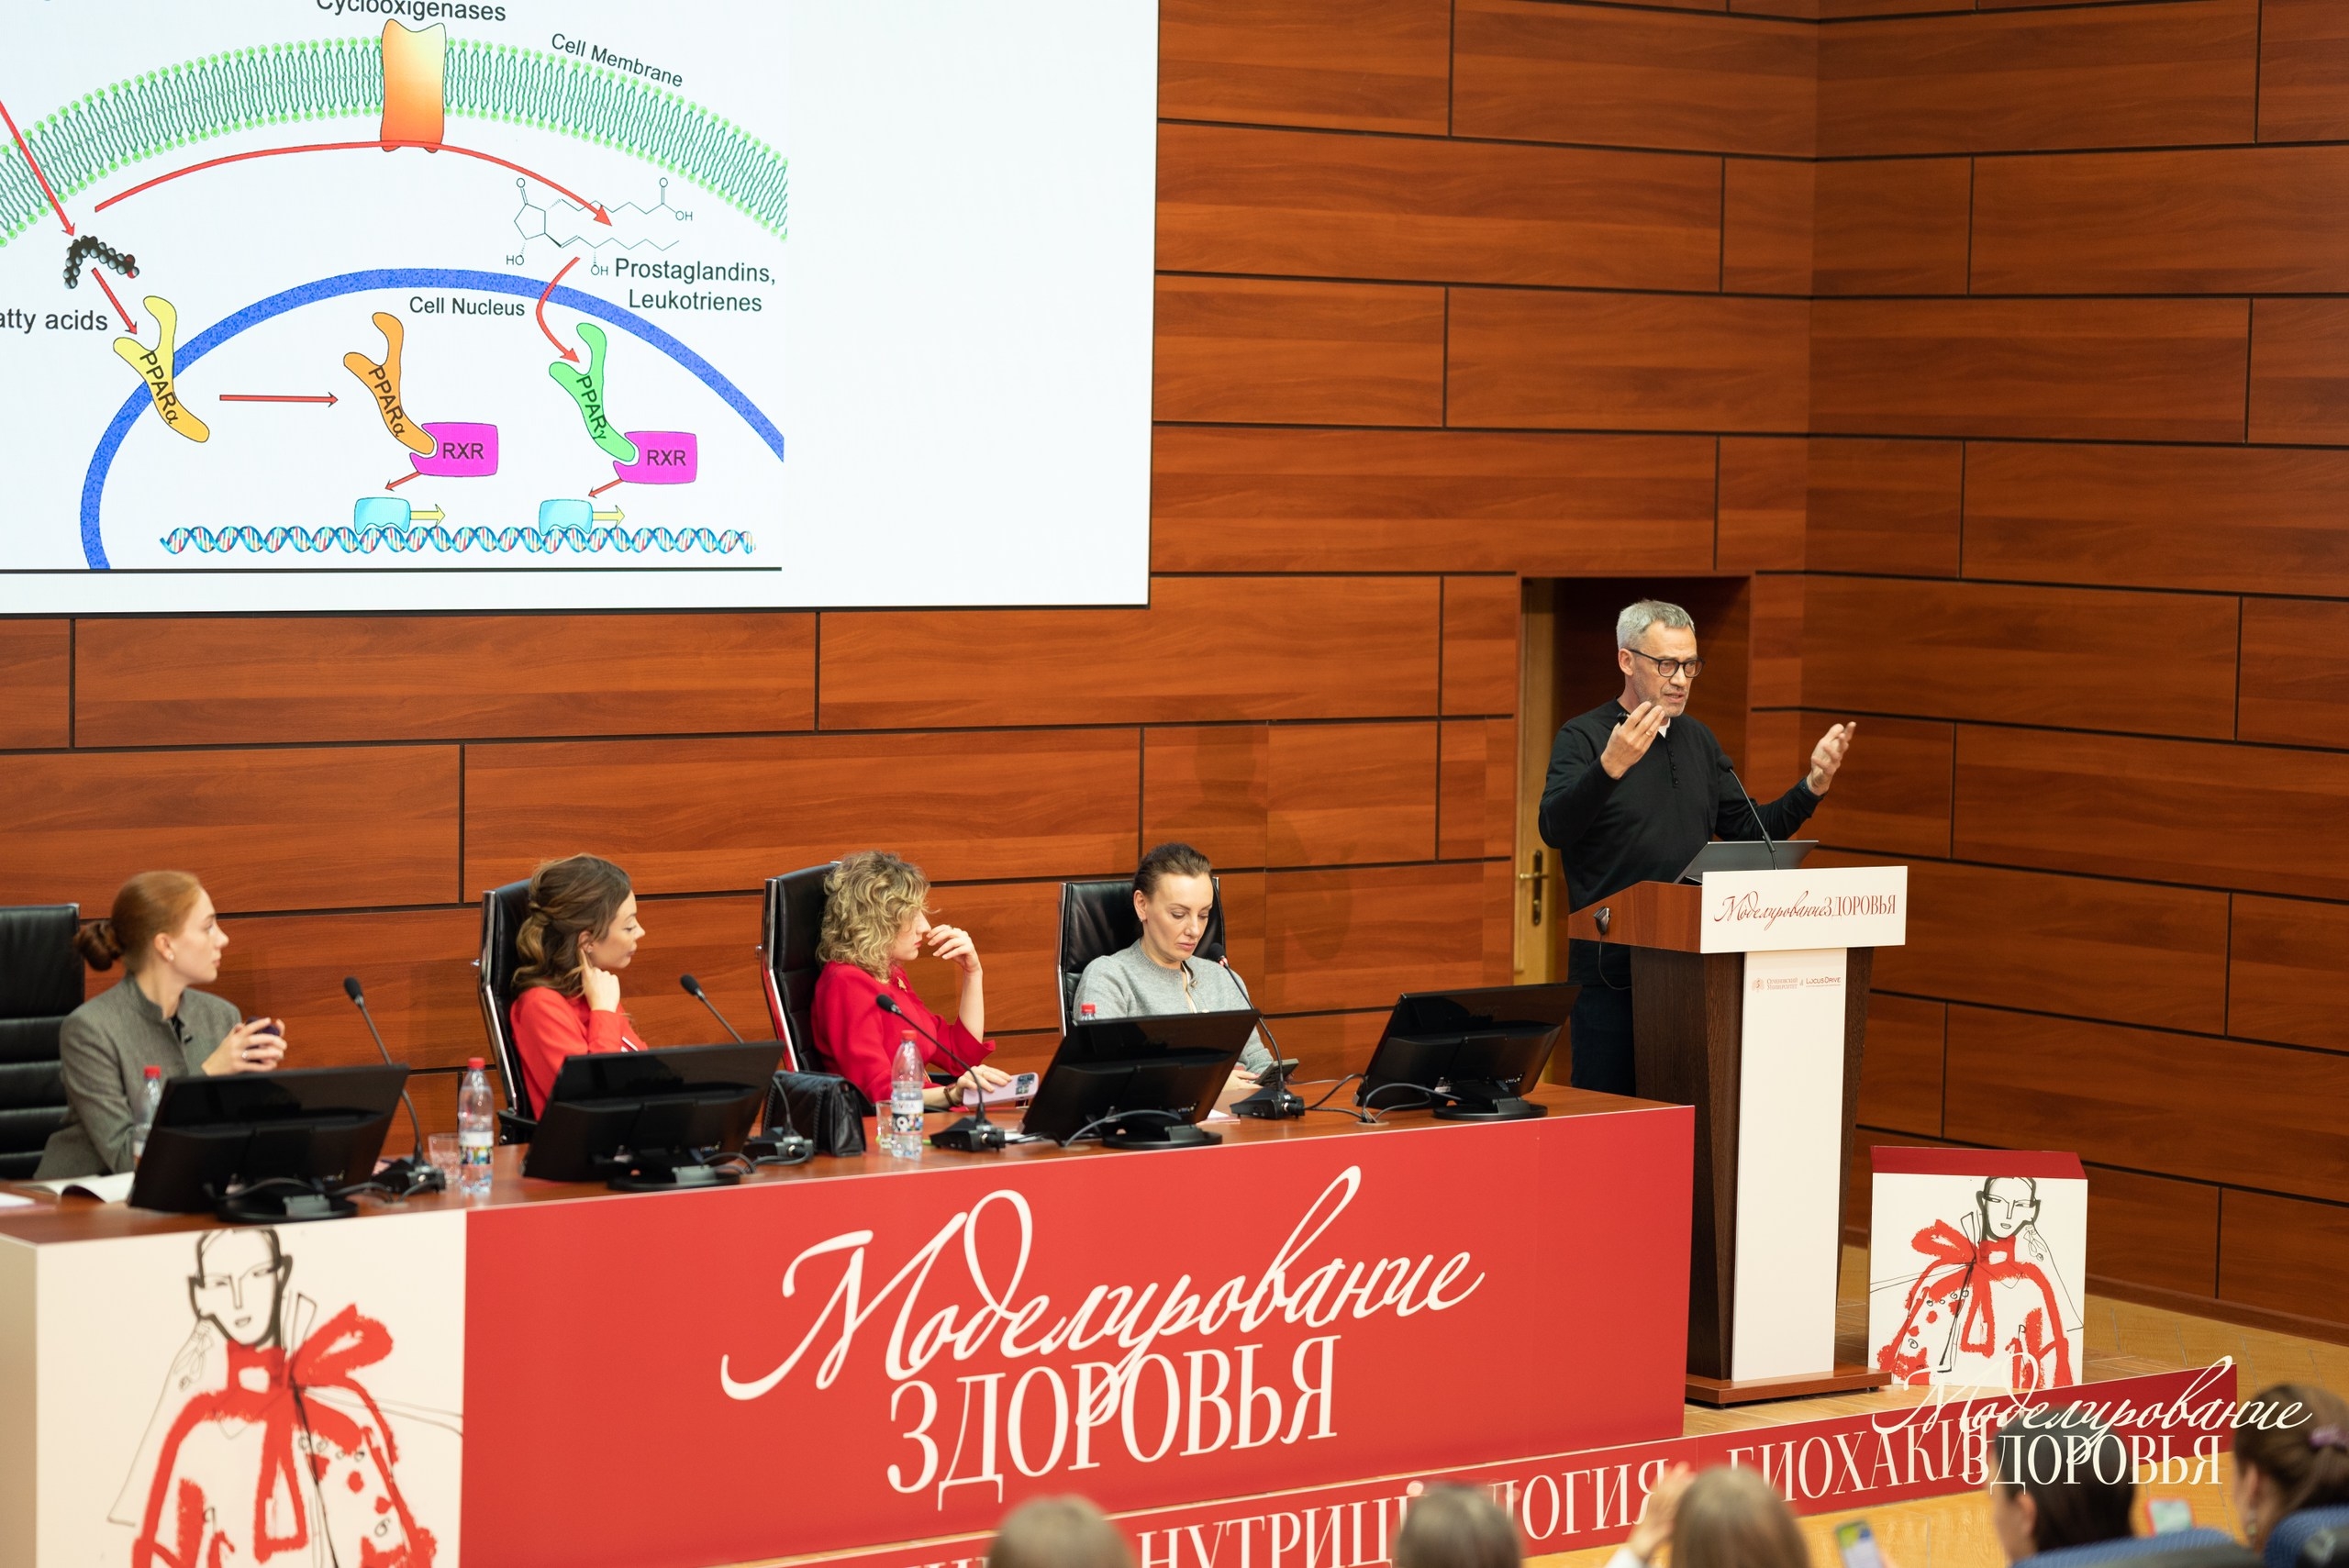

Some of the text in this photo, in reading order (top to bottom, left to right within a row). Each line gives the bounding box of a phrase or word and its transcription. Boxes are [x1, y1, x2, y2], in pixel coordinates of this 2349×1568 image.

[316, 0, 507, 21] Cyclooxigenases
[551, 33, 684, 88] Cell Membrane
[674, 210, 694, 222] OH
[506, 255, 525, 267] HO
[590, 265, 609, 277] OH
[615, 258, 776, 285] Prostaglandins,
[409, 295, 526, 317] Cell Nucleus
[629, 289, 763, 313] Leukotrienes
[45, 309, 108, 331] acids
[442, 443, 484, 461] RXR
[646, 450, 687, 468] RXR
[719, 1164, 1485, 1429] Моделирование
[886, 1334, 1342, 1512] ЗДОРОВЬЯ
